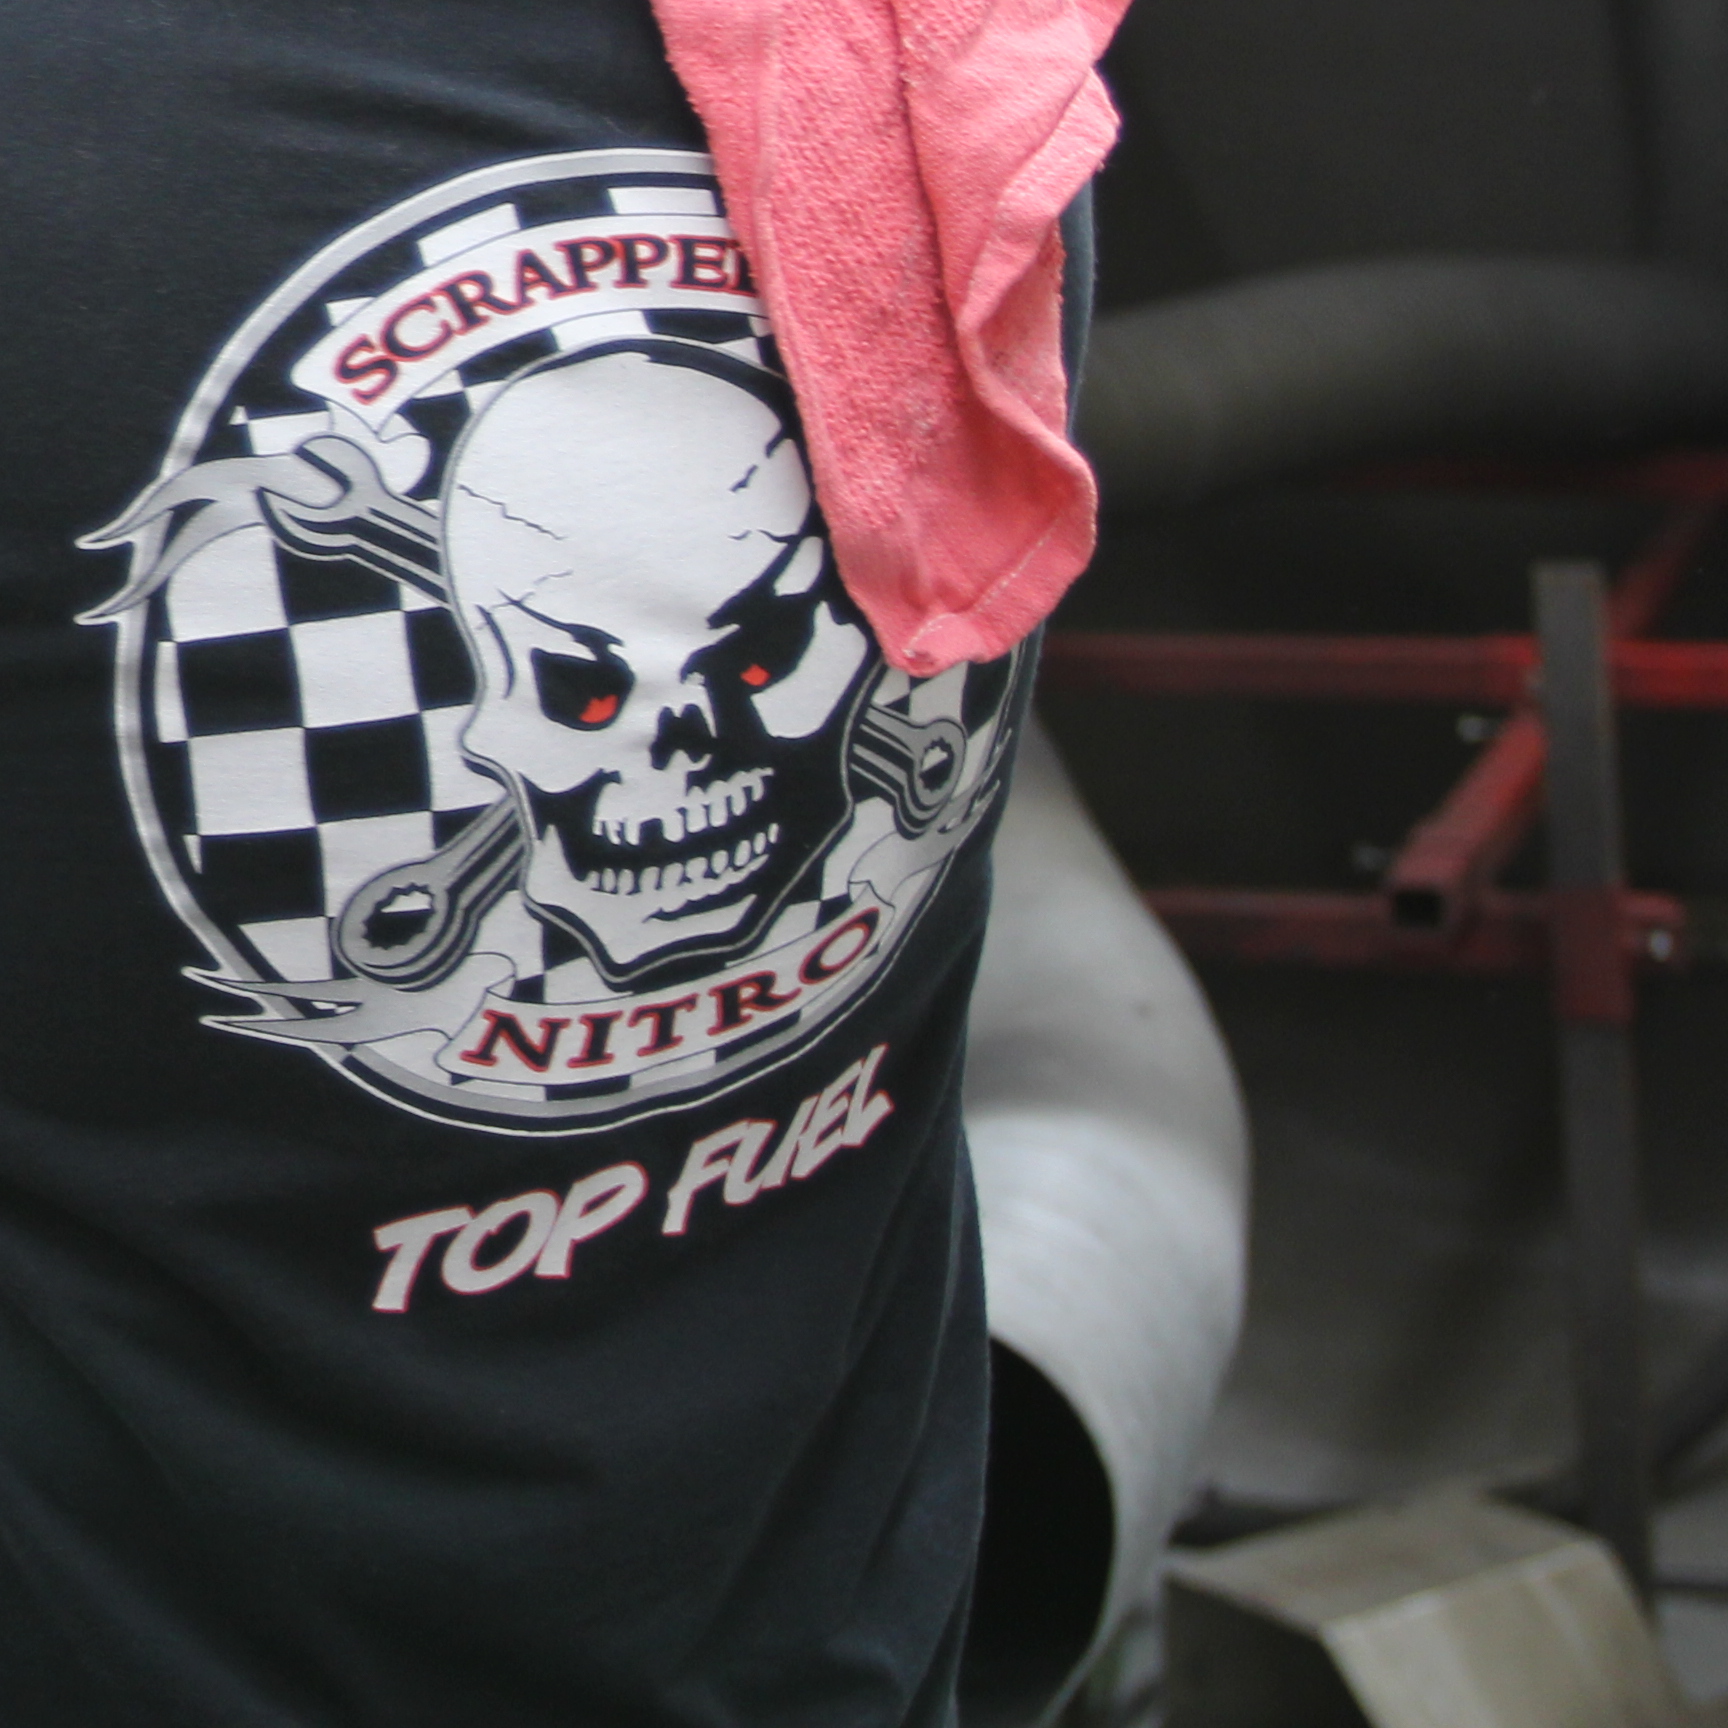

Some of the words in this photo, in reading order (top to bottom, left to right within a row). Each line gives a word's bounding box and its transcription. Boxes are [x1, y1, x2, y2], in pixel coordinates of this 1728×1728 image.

[460, 904, 881, 1072] NITRO
[372, 1160, 648, 1313] TOP
[661, 1042, 894, 1236] FUEL
